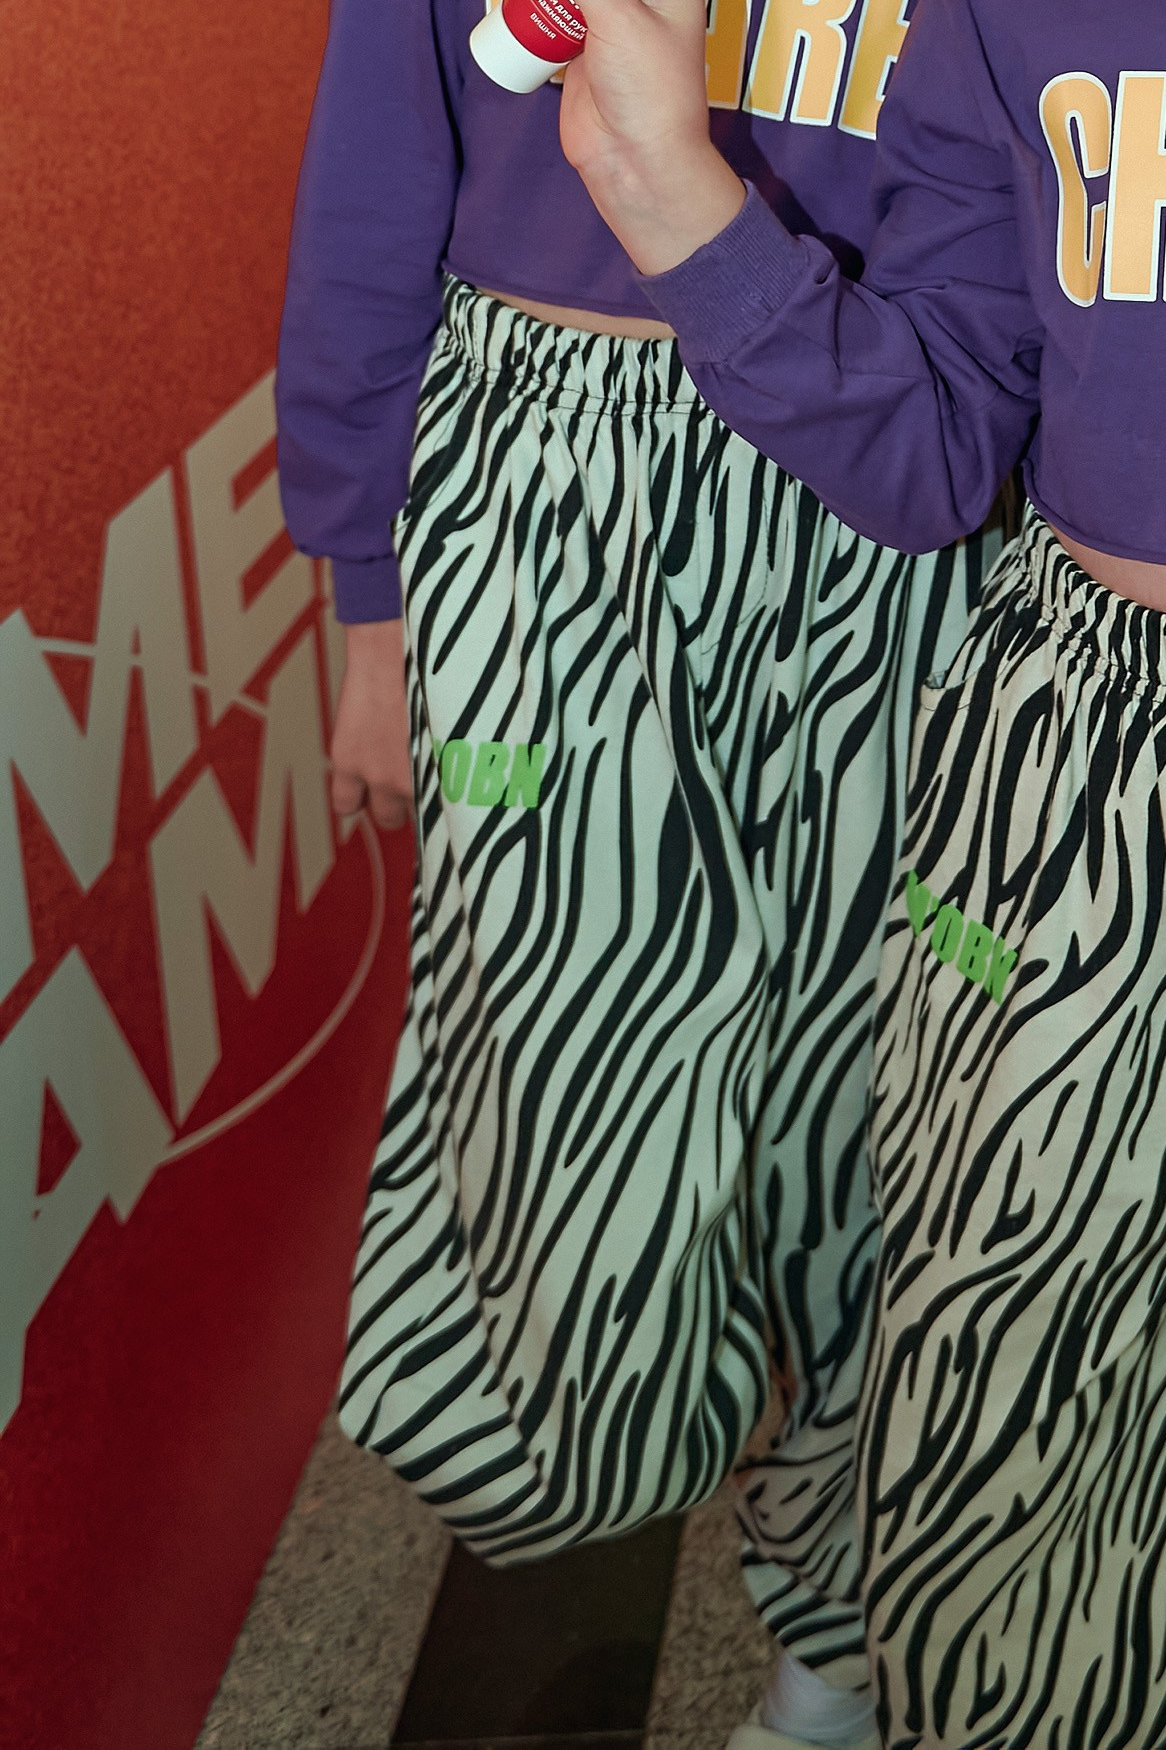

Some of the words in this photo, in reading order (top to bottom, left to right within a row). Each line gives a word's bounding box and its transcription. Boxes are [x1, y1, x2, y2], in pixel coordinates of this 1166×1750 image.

[529, 12, 557, 40] вишня
[554, 4, 573, 21] для
[569, 19, 588, 33] рук
[0, 367, 312, 1015] ME
